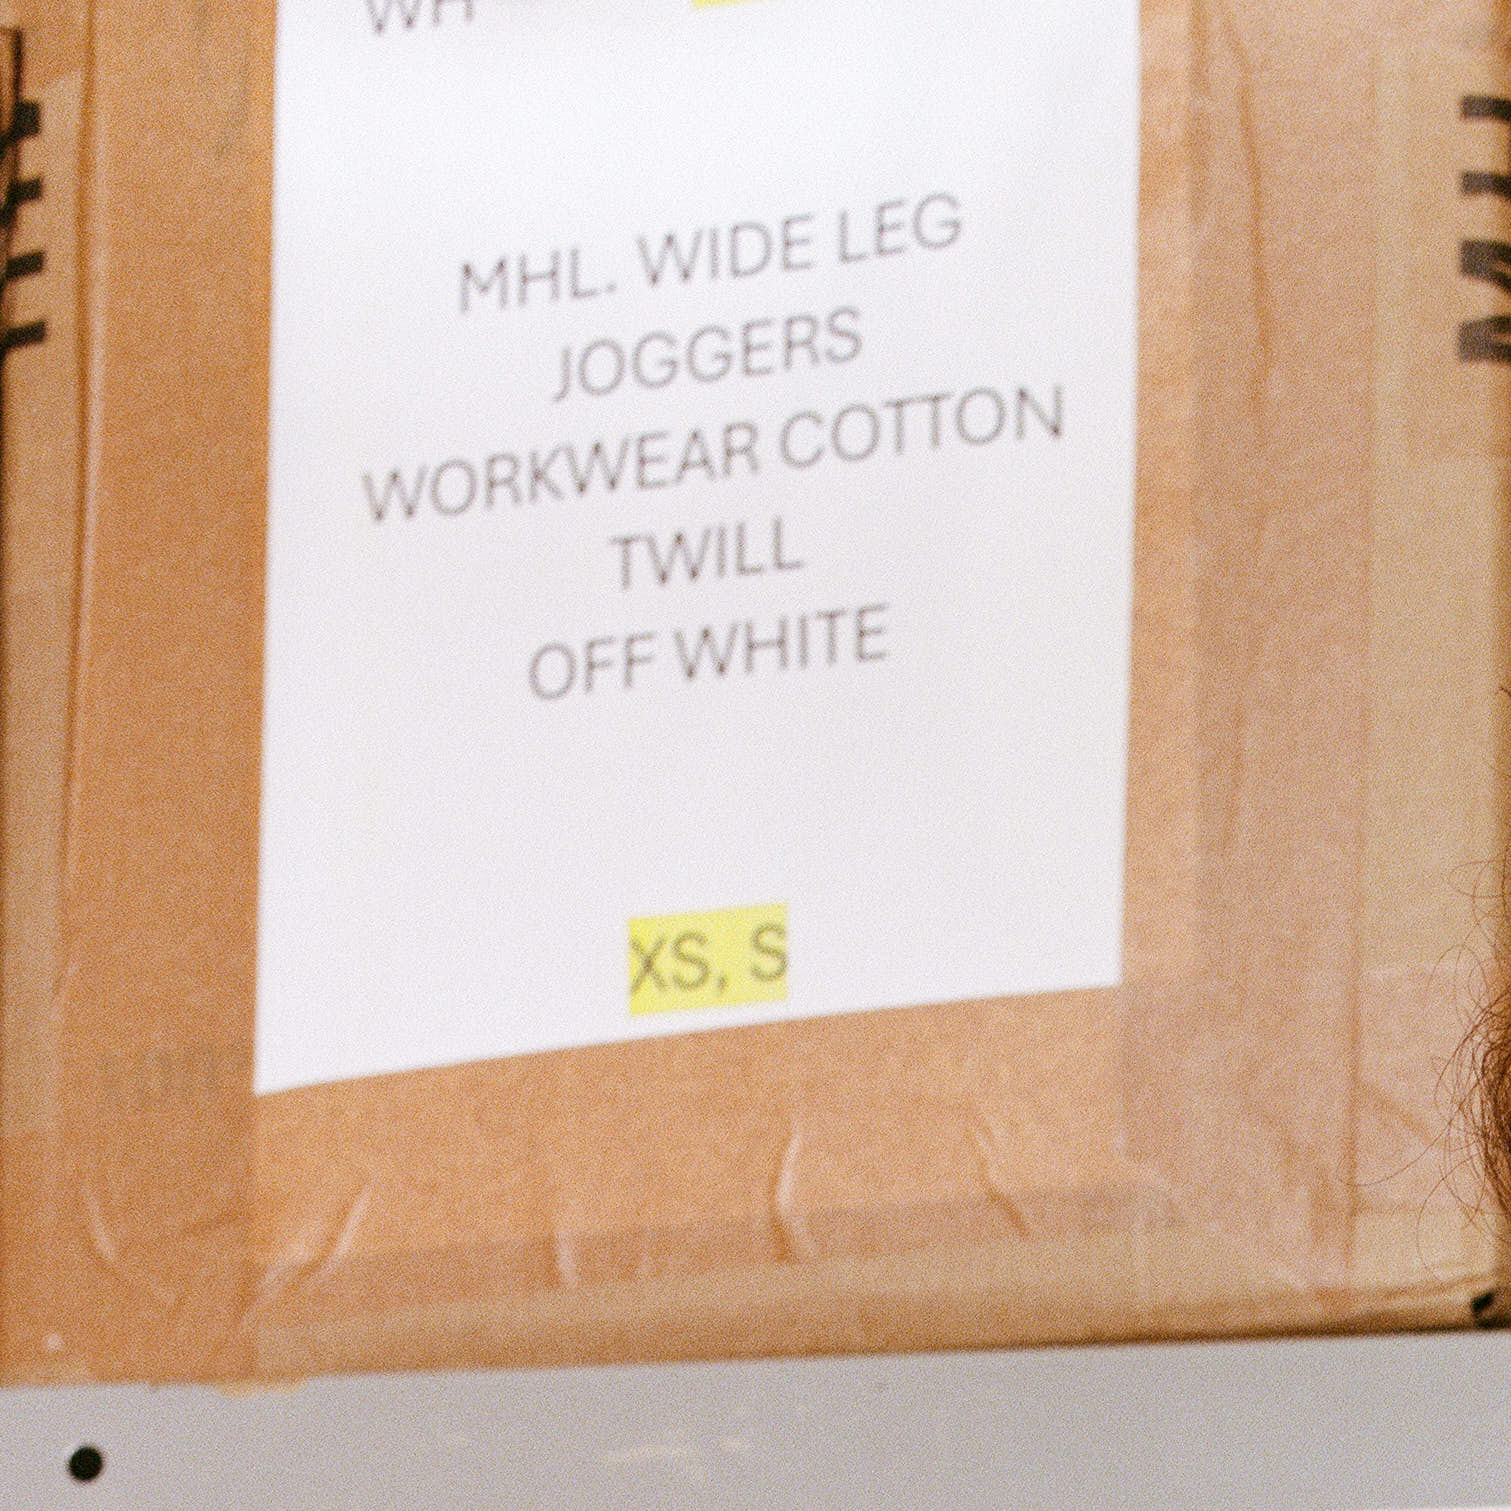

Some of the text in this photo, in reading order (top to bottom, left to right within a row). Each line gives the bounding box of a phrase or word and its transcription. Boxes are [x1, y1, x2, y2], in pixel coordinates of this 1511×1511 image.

[457, 192, 964, 313] MHL. WIDE LEG
[552, 305, 864, 403] JOGGERS
[361, 384, 1066, 523] WORKWEAR COTTON
[610, 516, 806, 591] TWILL
[528, 603, 892, 701] OFF WHITE
[630, 922, 789, 996] XS, S
